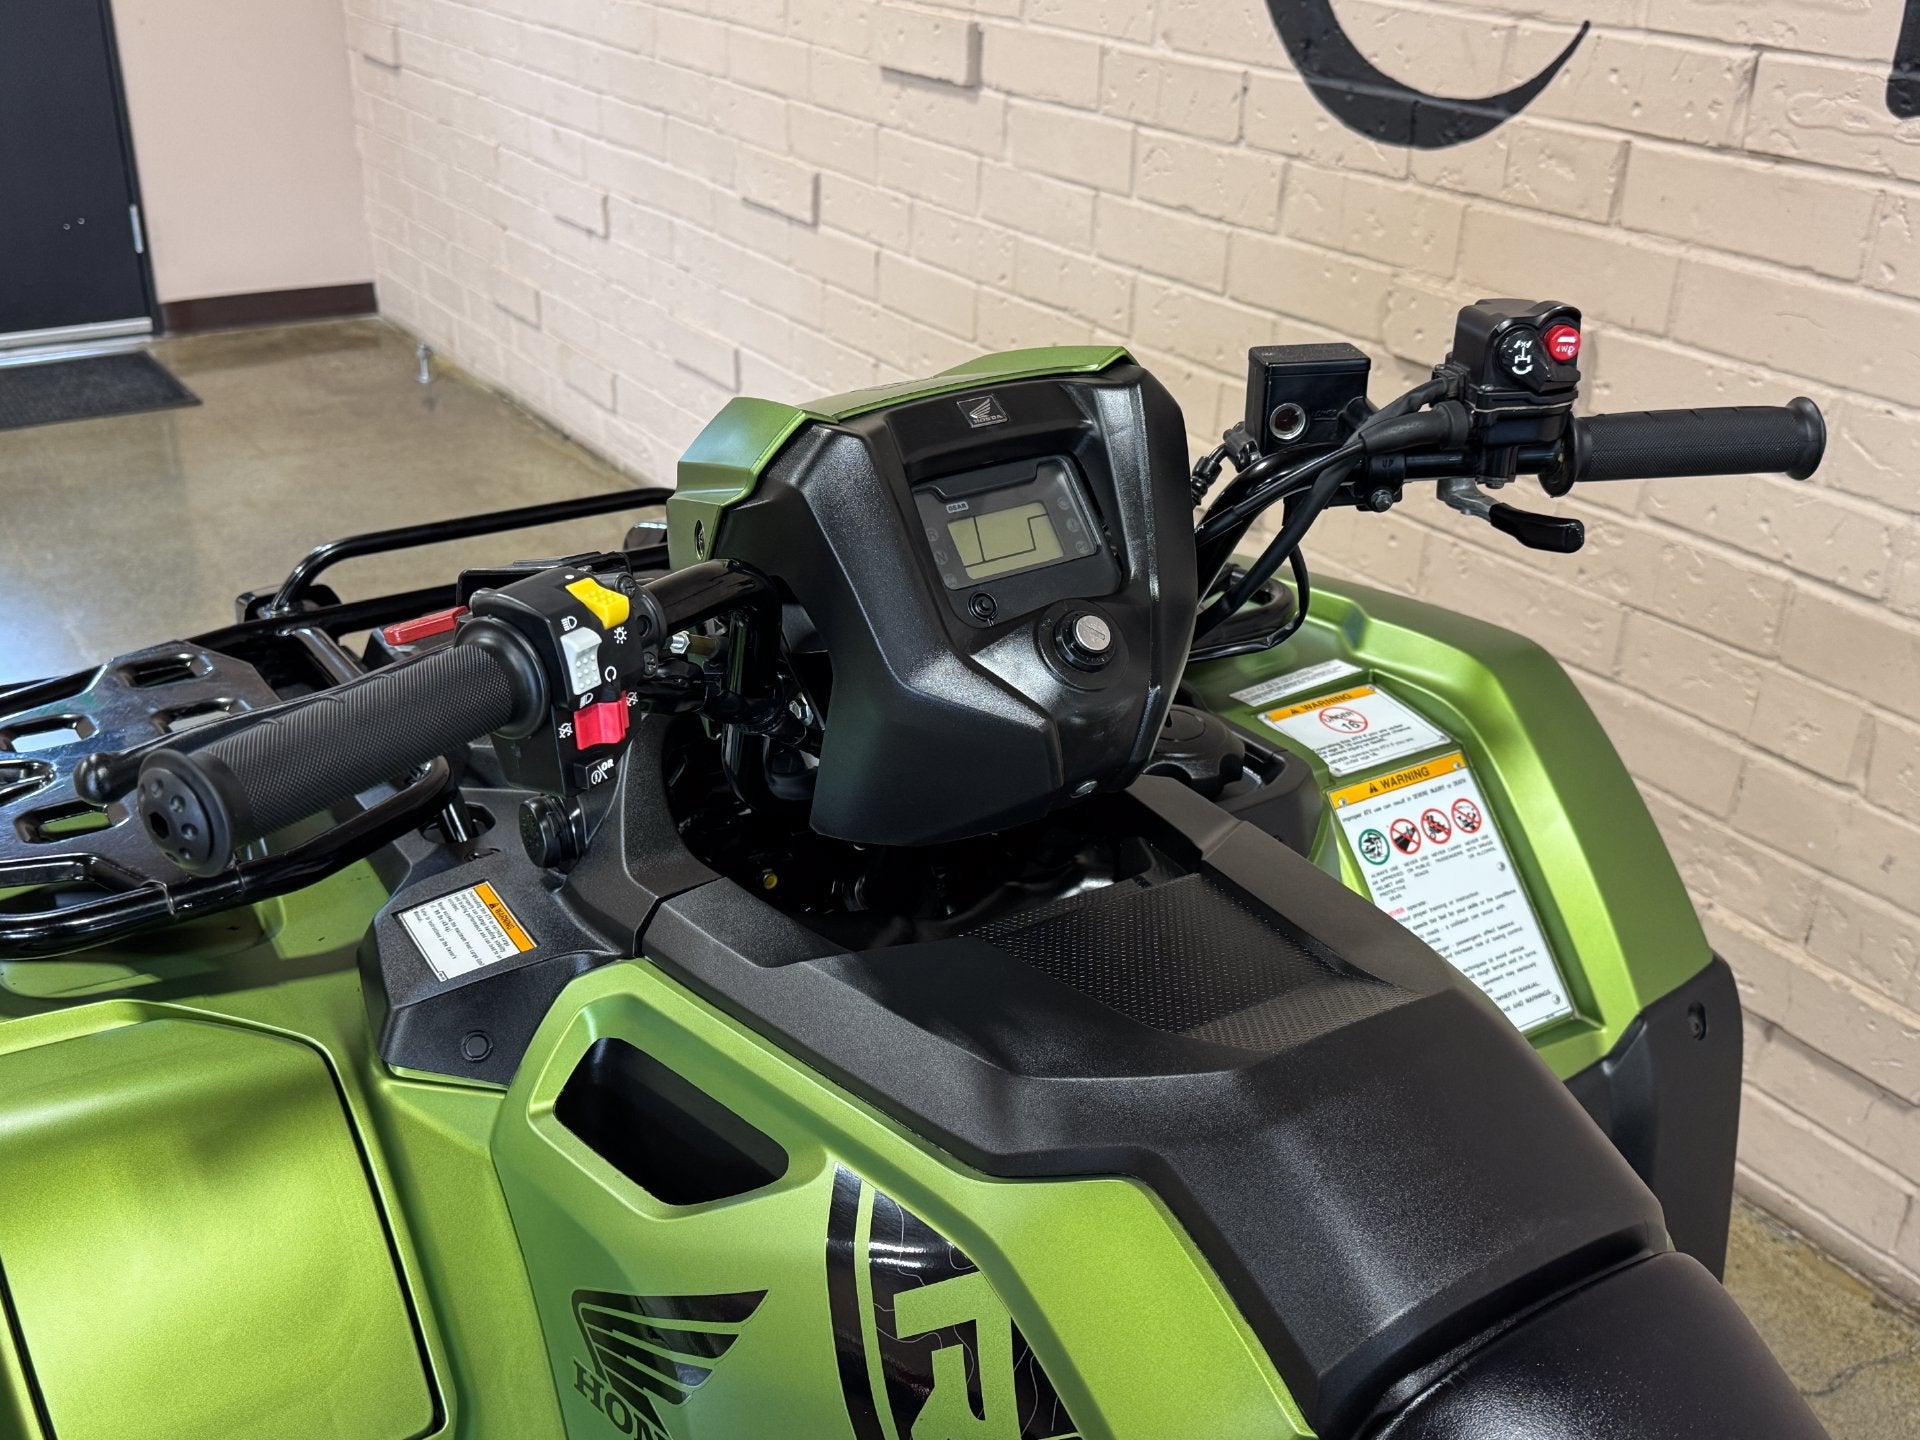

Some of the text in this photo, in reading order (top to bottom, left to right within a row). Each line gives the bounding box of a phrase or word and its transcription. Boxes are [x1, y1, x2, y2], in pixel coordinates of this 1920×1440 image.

[1555, 344, 1576, 355] 4WD
[973, 414, 1004, 423] HONDA
[948, 503, 967, 512] GEAR
[1301, 693, 1354, 710] WARNING
[1341, 721, 1361, 732] 16
[601, 759, 614, 771] OR
[1380, 766, 1431, 790] WARNING
[496, 907, 516, 931] WARNING
